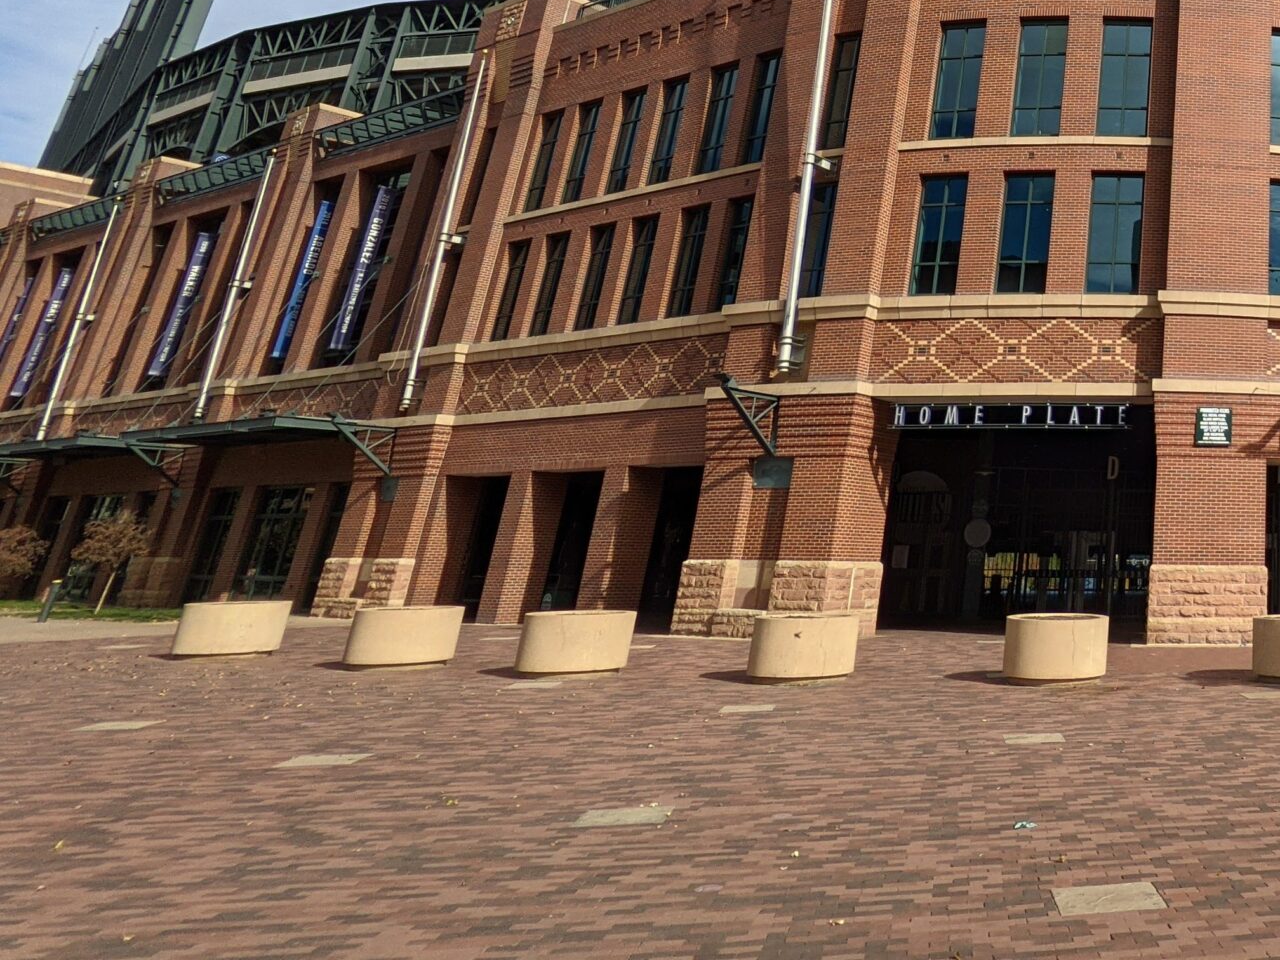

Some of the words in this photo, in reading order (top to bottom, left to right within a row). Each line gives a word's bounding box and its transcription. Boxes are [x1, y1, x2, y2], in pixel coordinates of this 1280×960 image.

[302, 234, 324, 275] ARENADO
[359, 216, 384, 264] GONZALEZ
[181, 264, 202, 297] WALKER
[894, 406, 985, 425] HOME
[1021, 406, 1127, 425] PLATE
[1108, 455, 1120, 480] D
